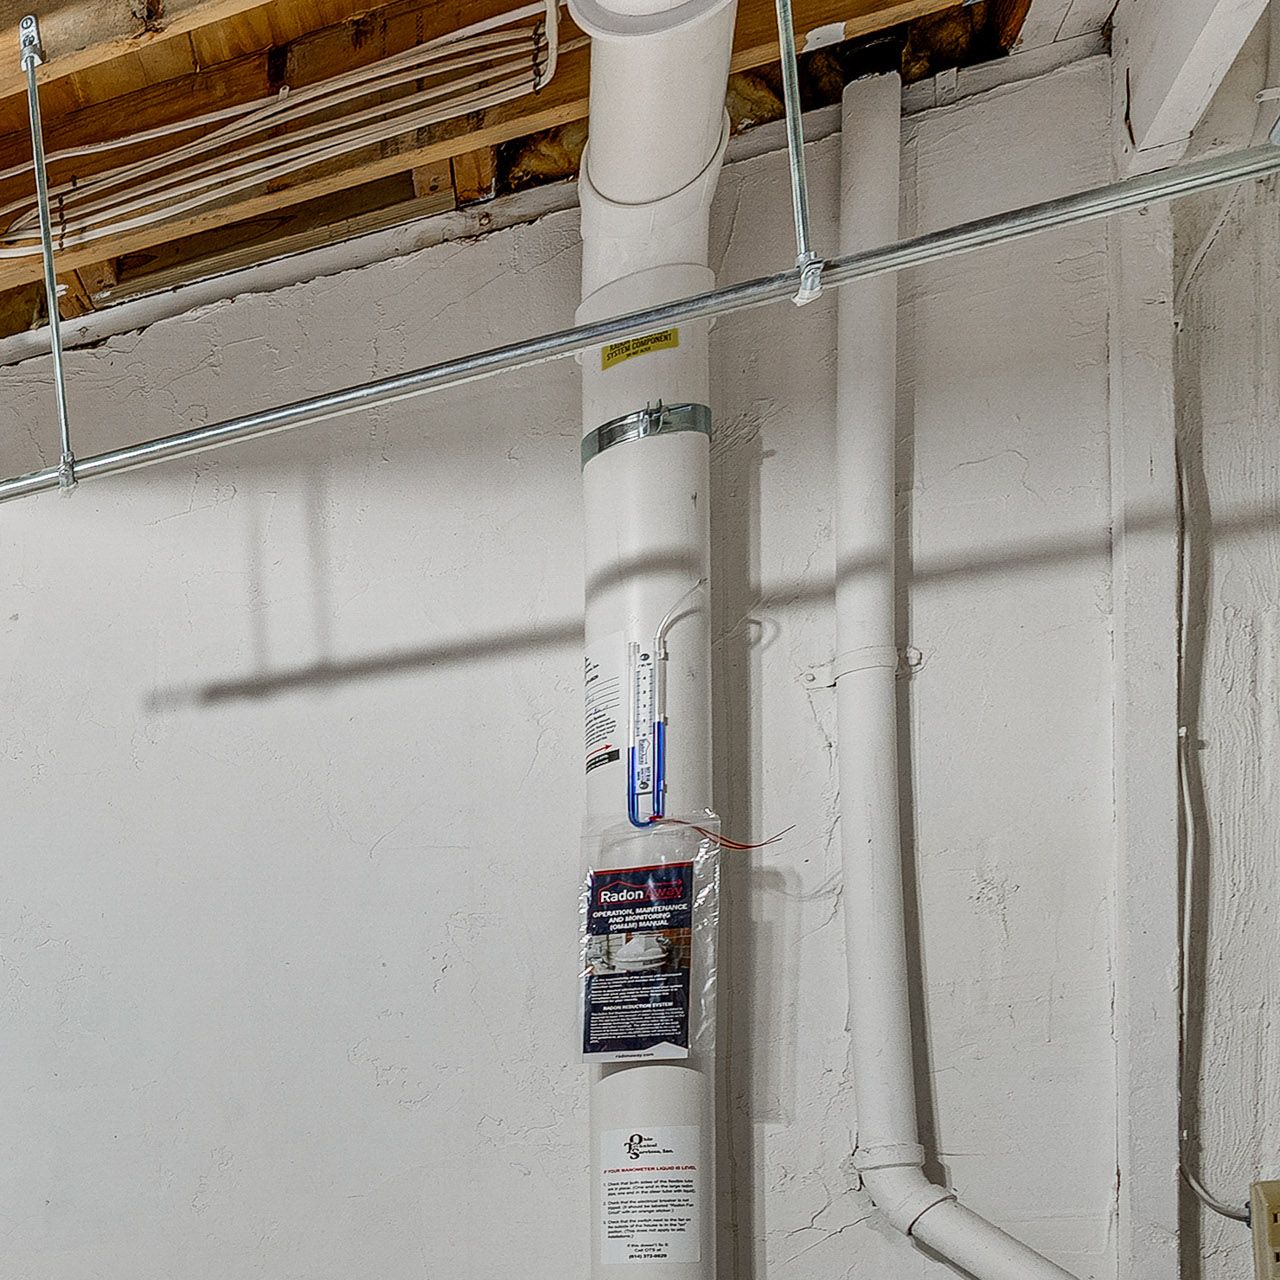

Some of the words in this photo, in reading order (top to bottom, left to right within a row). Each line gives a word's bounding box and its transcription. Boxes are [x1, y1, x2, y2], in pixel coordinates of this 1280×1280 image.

[606, 345, 631, 361] SYSTEM
[631, 333, 673, 350] COMPONENT
[608, 916, 624, 924] AND
[625, 912, 671, 922] MONITORING
